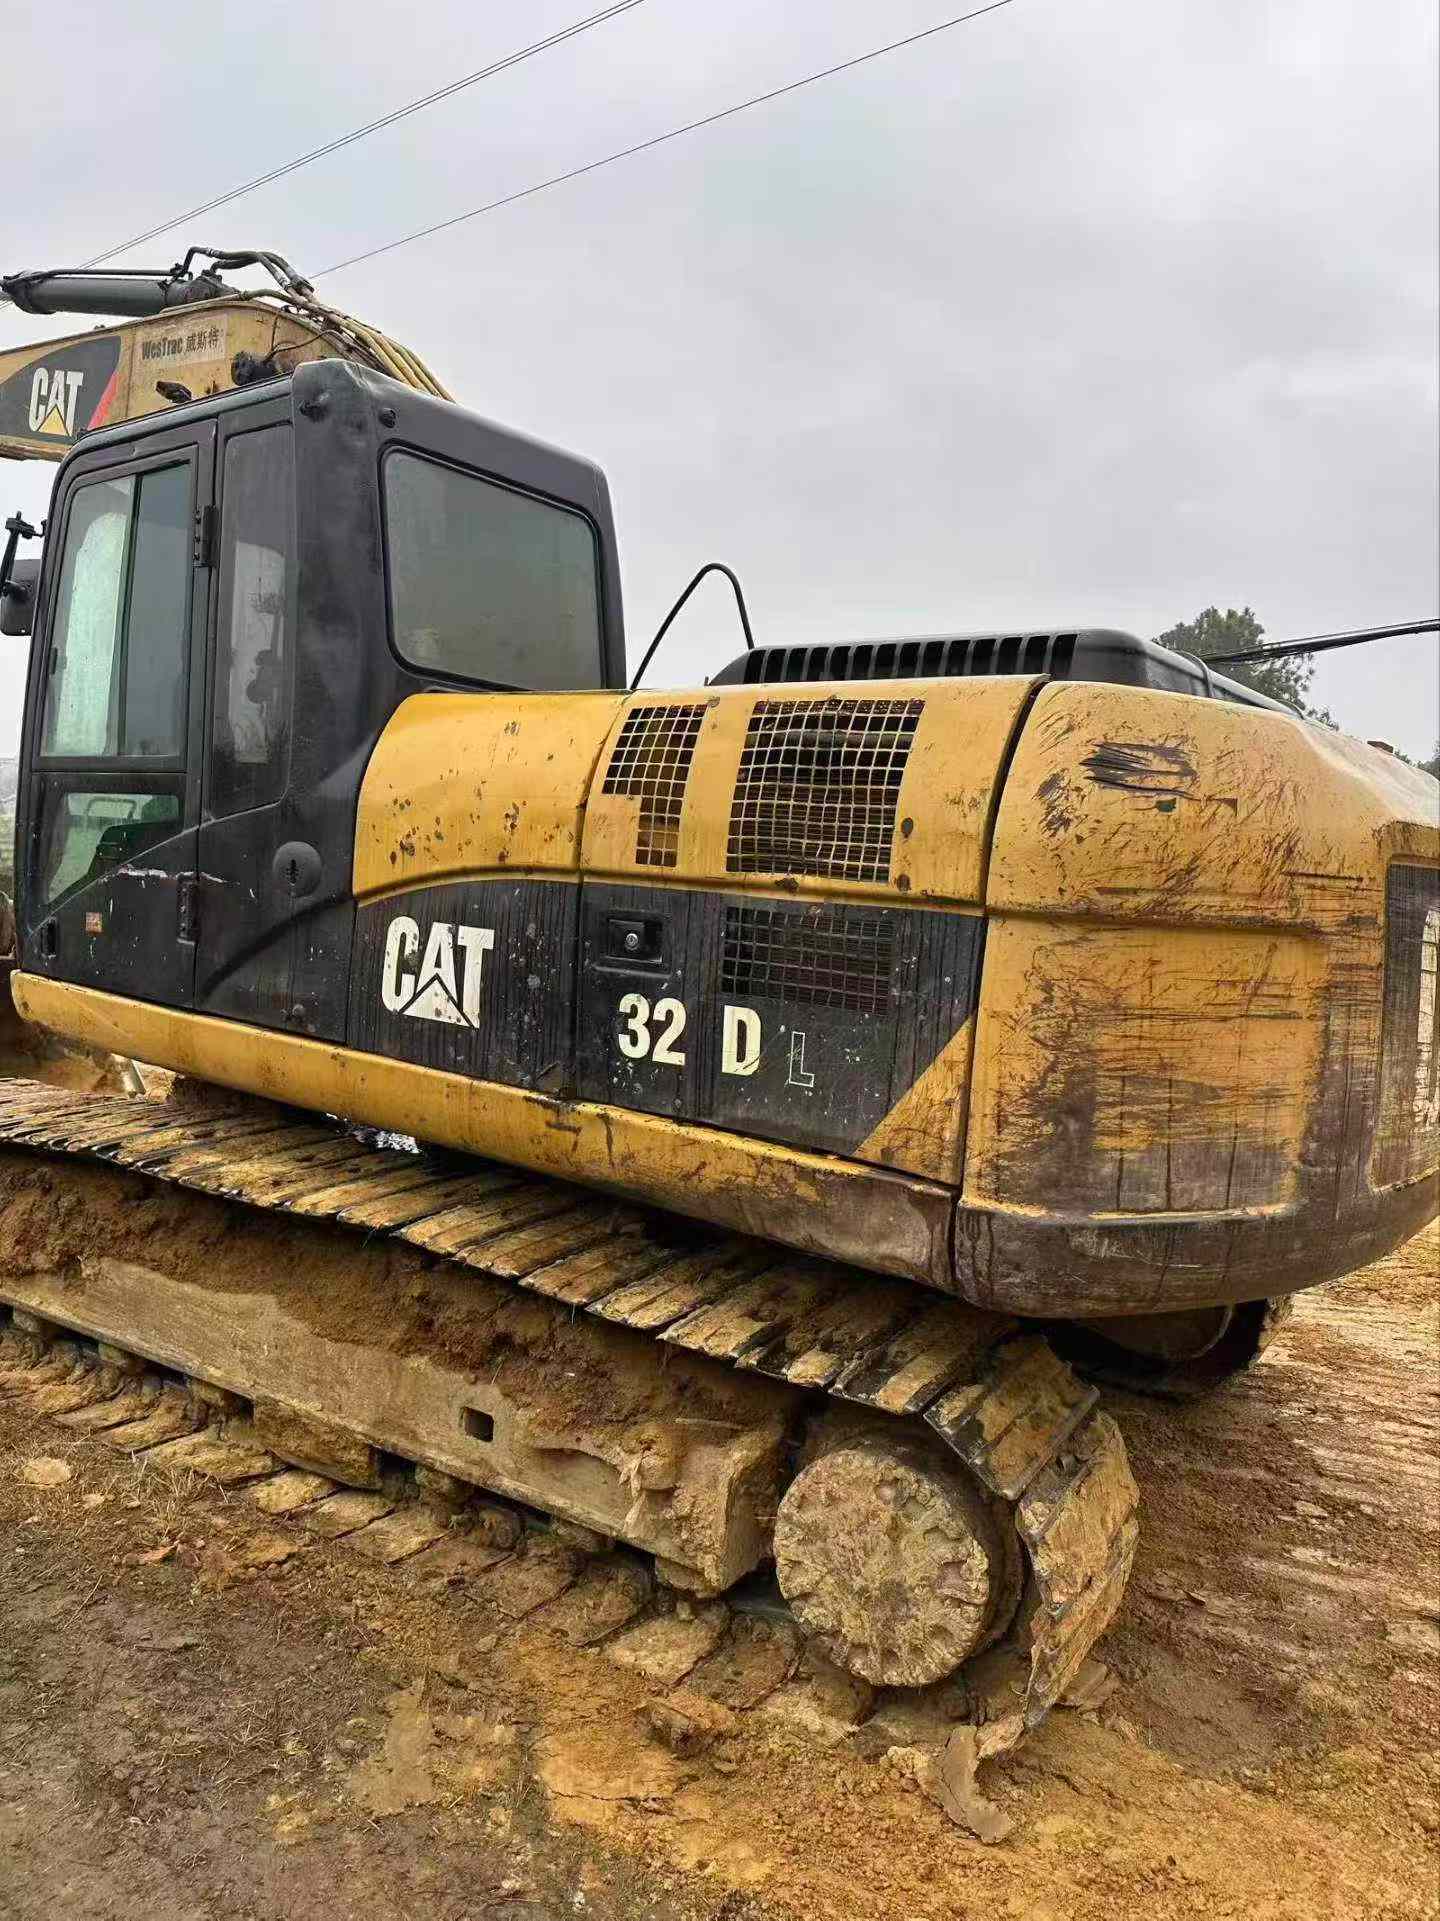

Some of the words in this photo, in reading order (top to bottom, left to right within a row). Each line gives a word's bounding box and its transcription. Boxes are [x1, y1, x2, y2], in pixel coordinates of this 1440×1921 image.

[143, 337, 183, 360] WesTrac
[186, 326, 219, 353] 威斯特
[29, 368, 84, 437] CAT
[382, 916, 495, 1029] CAT
[618, 993, 687, 1066] 32
[722, 1005, 762, 1076] D
[789, 1031, 815, 1088] L
